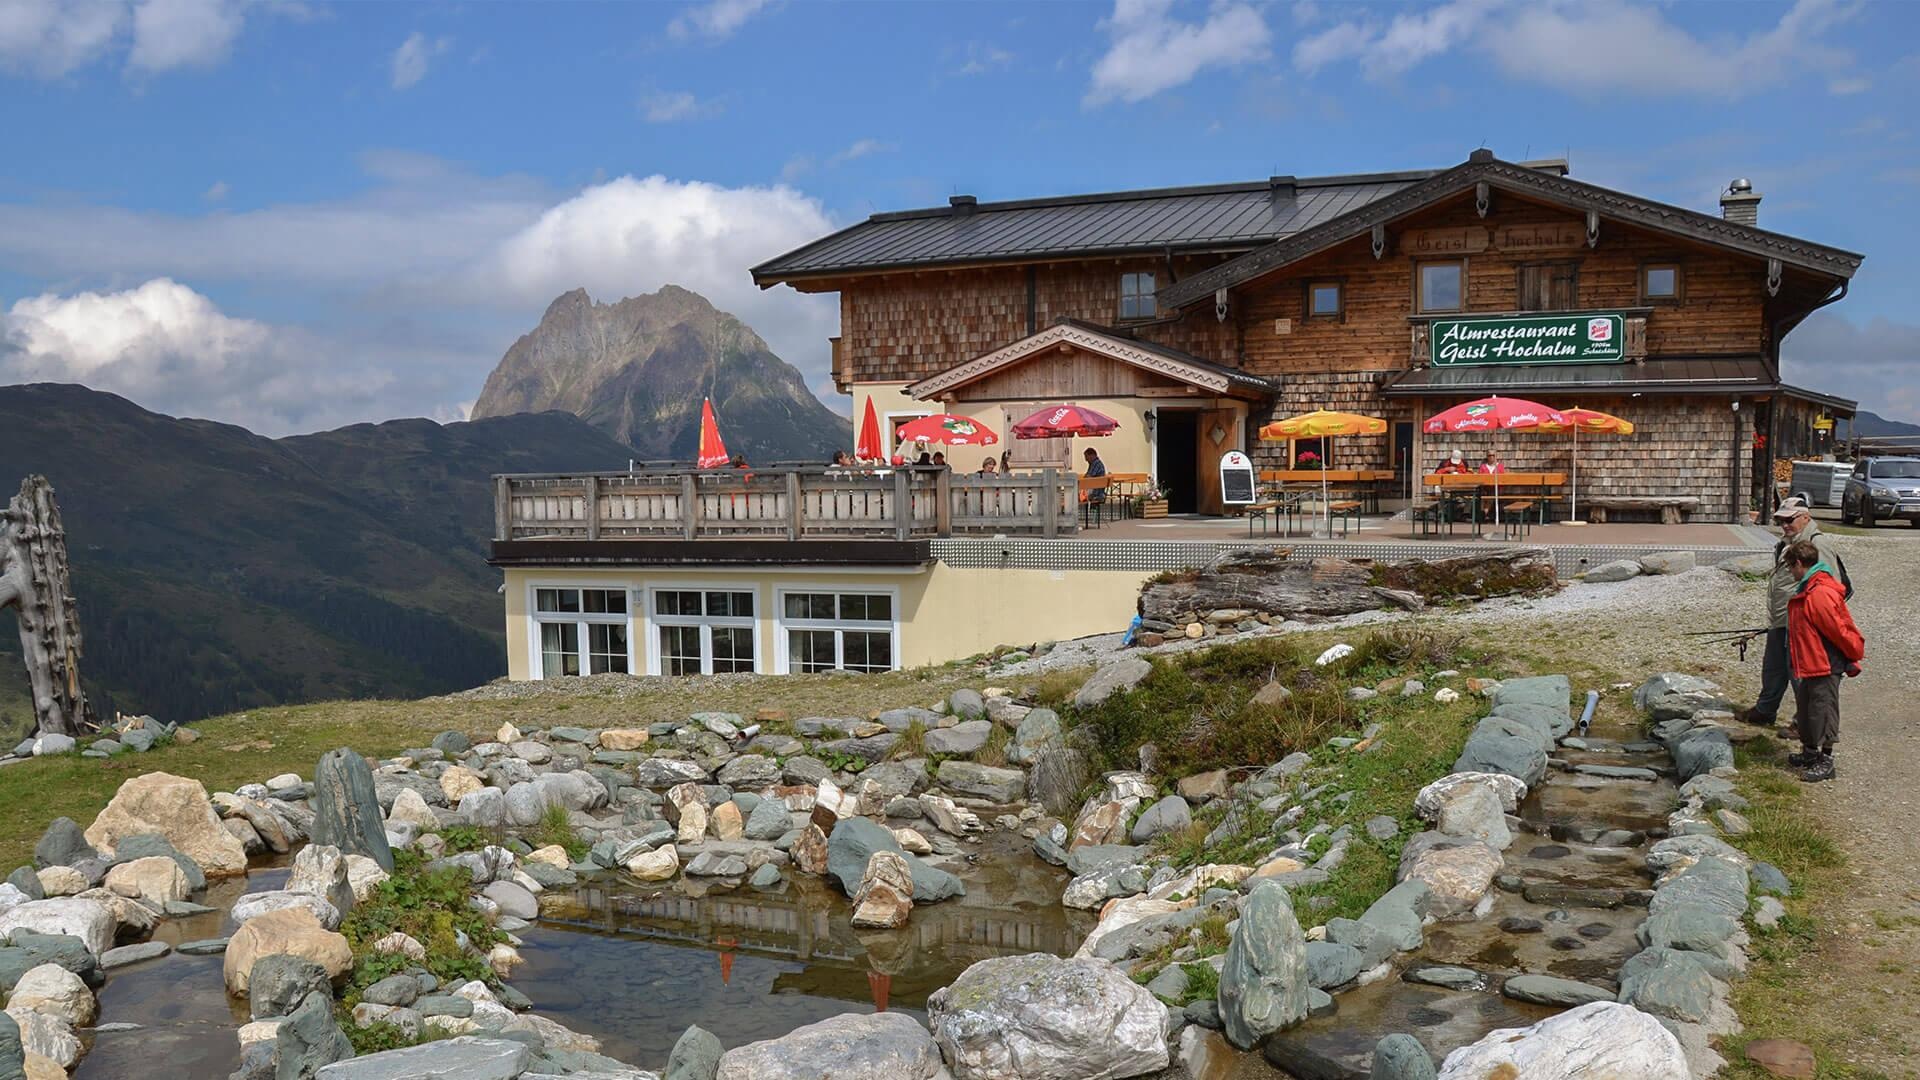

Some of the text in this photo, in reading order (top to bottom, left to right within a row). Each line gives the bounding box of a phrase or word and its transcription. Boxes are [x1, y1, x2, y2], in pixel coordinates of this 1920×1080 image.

[1440, 323, 1577, 345] Almrestaurant
[1440, 339, 1577, 363] Geisl Hochalm
